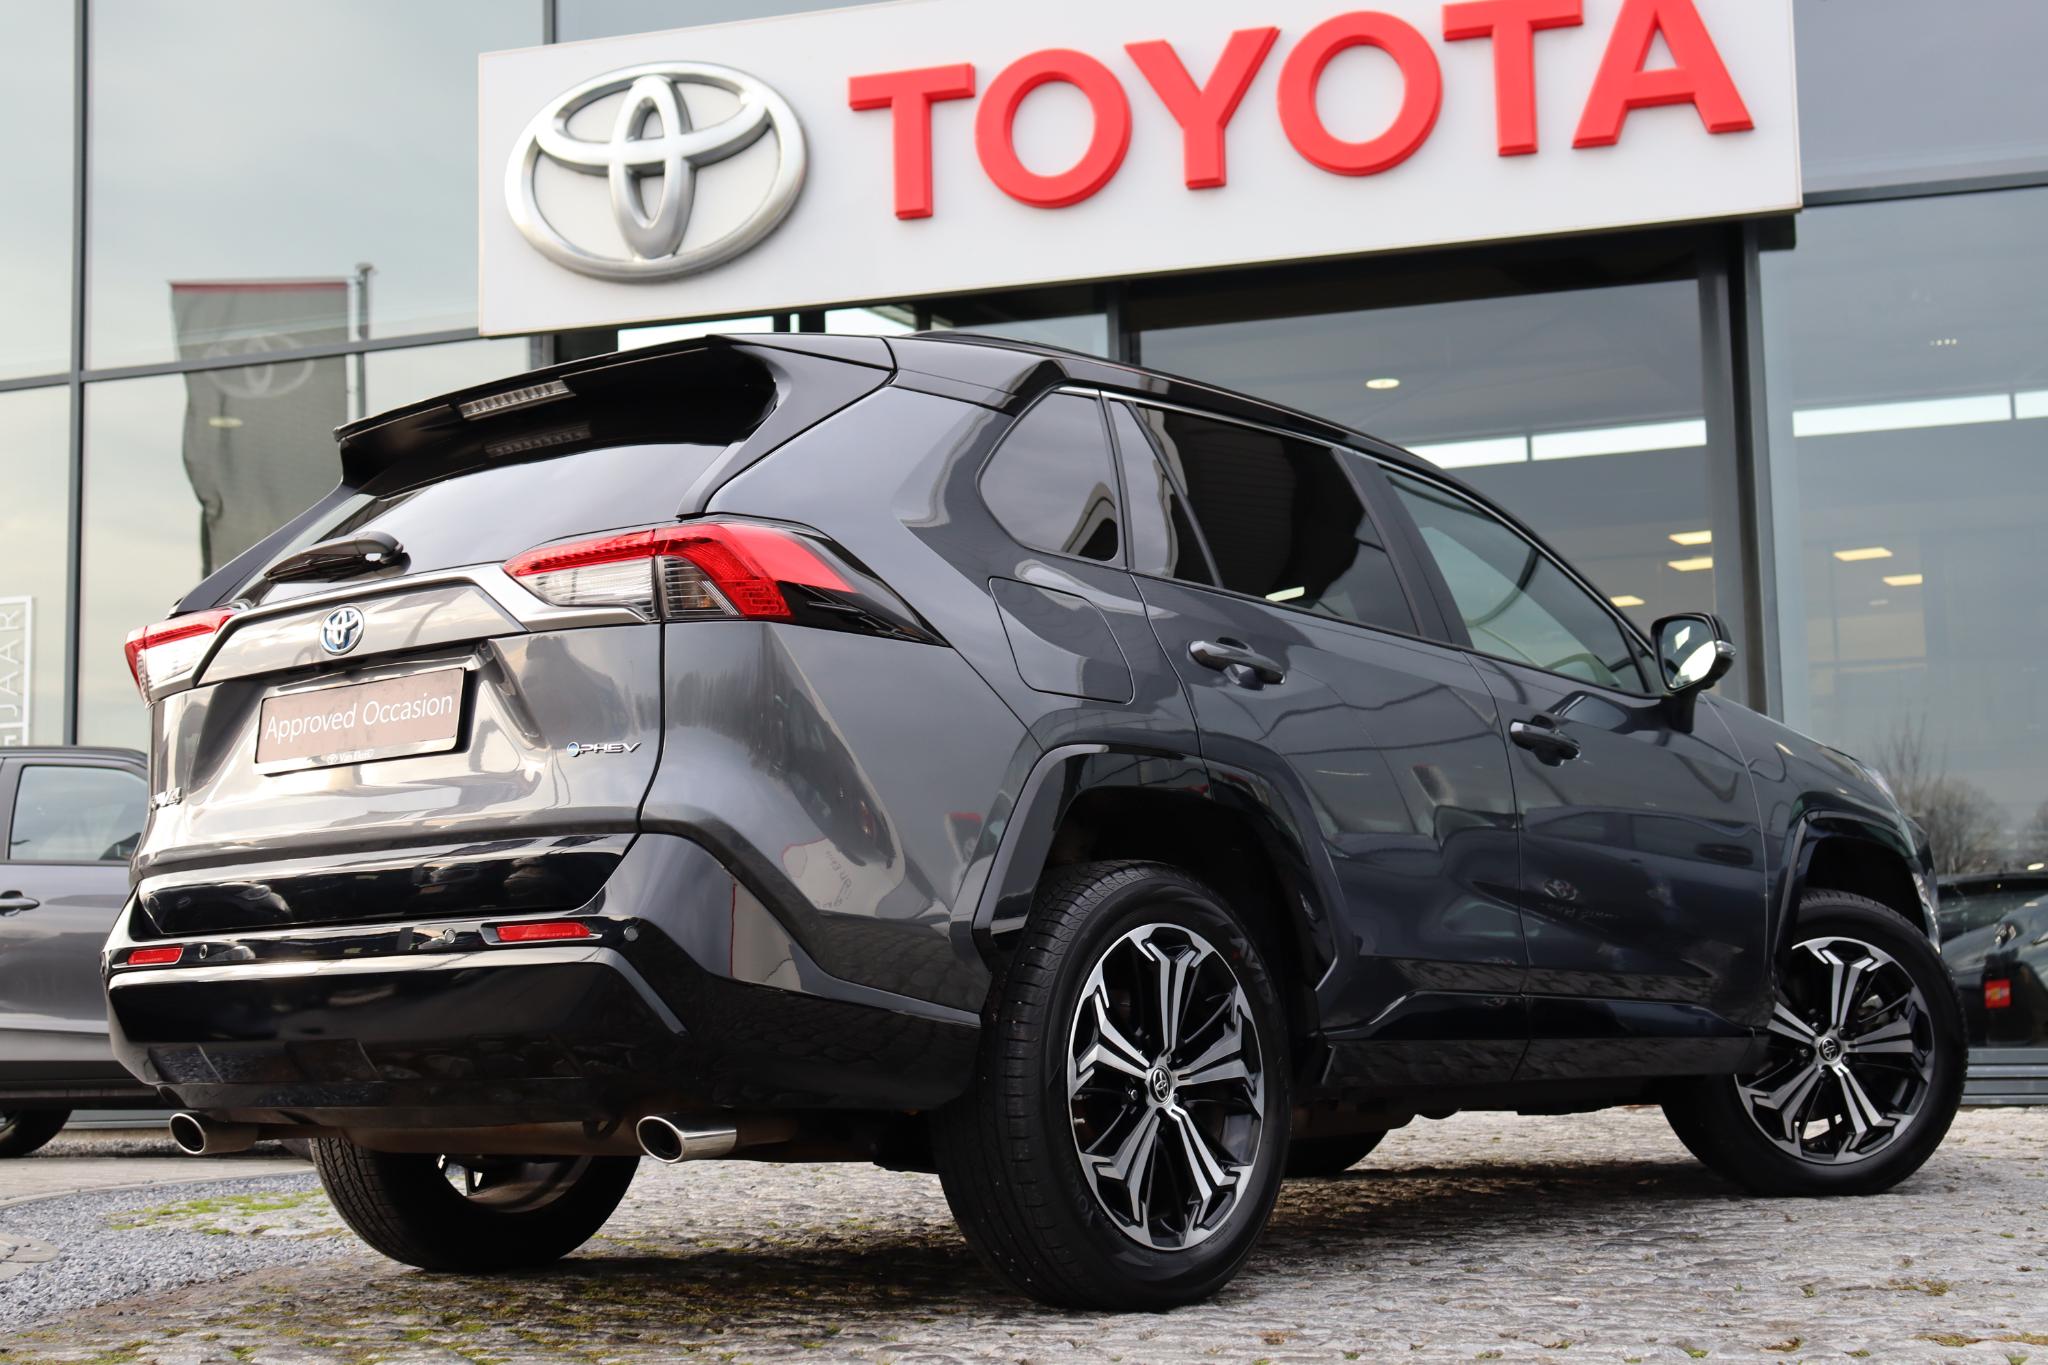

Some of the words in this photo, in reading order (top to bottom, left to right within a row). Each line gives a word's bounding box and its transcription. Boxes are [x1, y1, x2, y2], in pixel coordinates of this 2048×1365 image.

[848, 0, 1755, 220] TOYOTA
[264, 701, 358, 745] Approved
[362, 692, 453, 727] Occasion
[579, 742, 642, 754] PHEV
